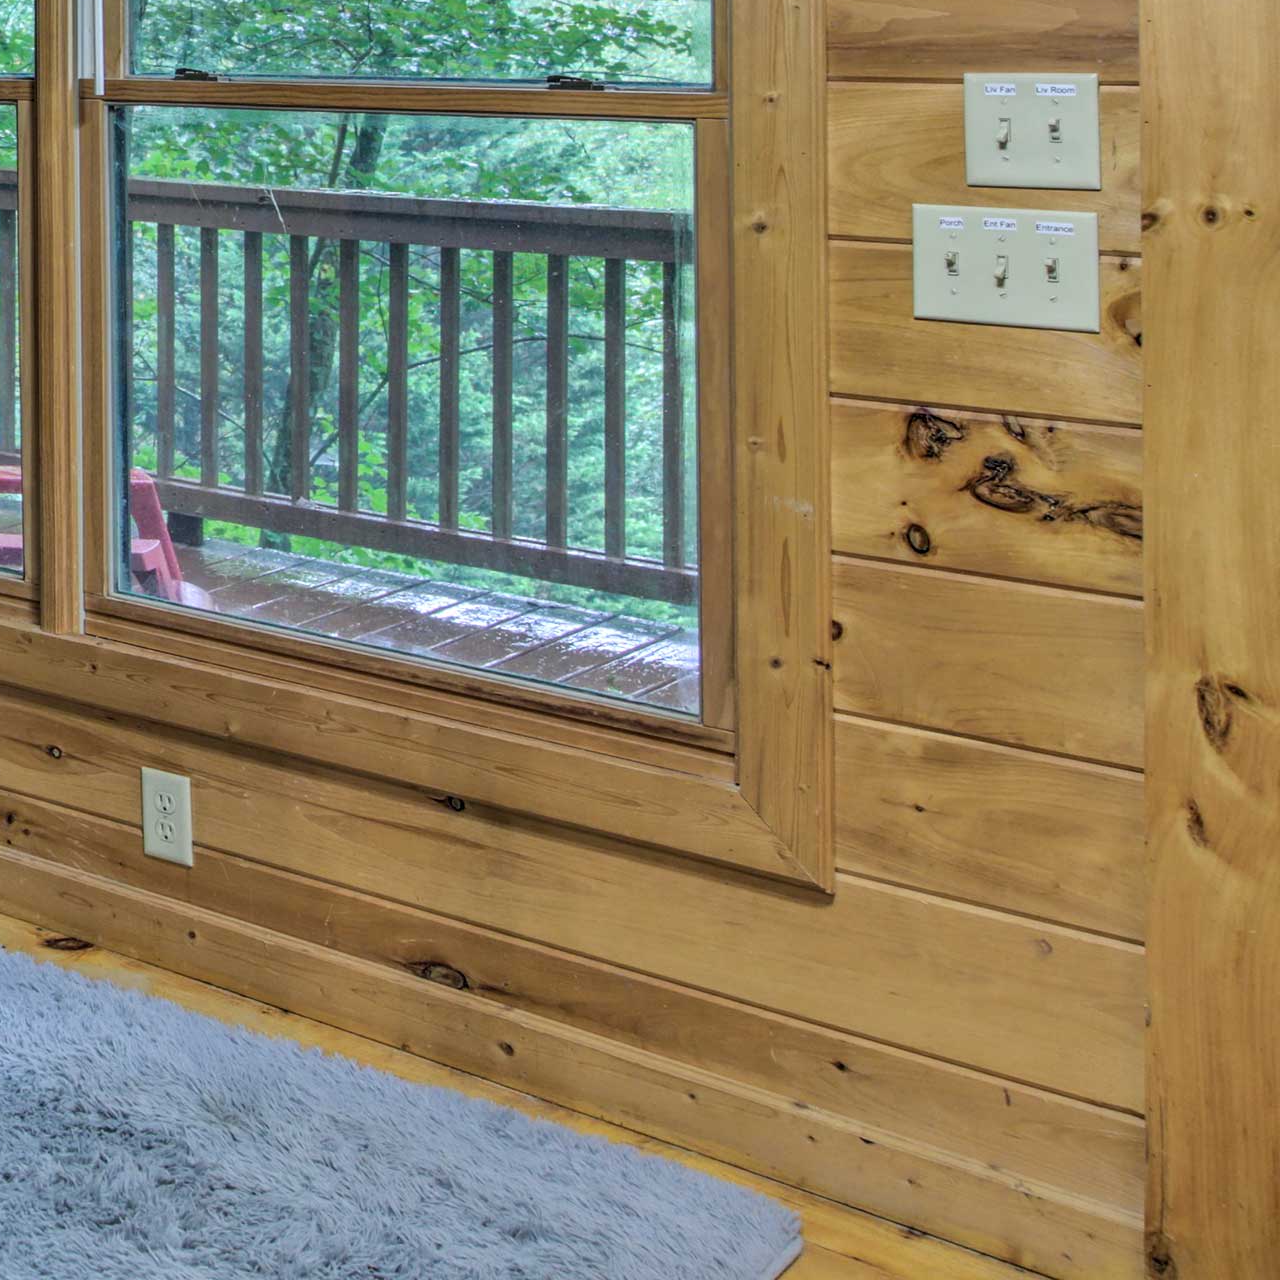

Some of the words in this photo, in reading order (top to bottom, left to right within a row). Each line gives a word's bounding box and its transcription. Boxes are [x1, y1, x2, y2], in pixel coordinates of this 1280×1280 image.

[1051, 86, 1075, 94] Room
[939, 218, 963, 227] Porch
[983, 219, 998, 228] Ent
[1000, 220, 1016, 229] Fan
[1036, 223, 1074, 233] Entrance
